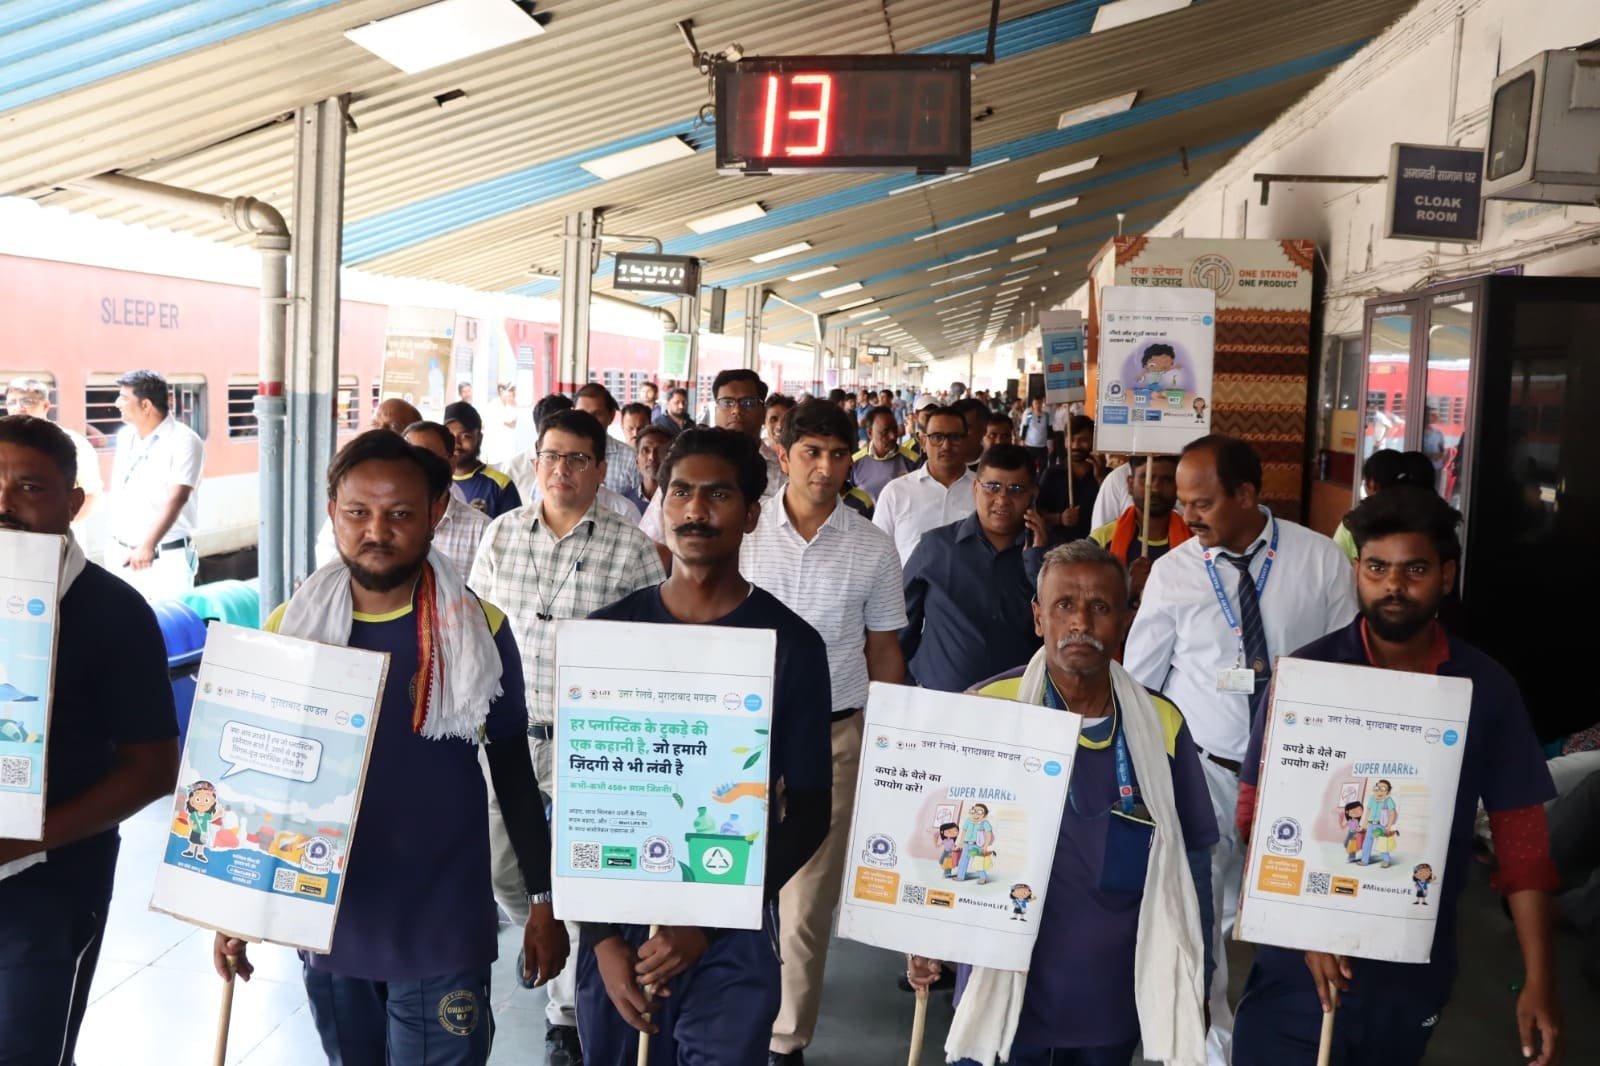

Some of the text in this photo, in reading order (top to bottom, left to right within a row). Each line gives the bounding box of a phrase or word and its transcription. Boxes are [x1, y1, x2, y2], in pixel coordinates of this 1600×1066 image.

[762, 73, 832, 157] 13
[1414, 195, 1461, 208] CLOAK
[1416, 210, 1457, 222] ROOM
[1131, 266, 1148, 276] एक
[1151, 264, 1184, 277] स्टेशन
[1239, 269, 1298, 279] ONE STATION
[1131, 277, 1147, 287] एक
[1239, 279, 1297, 288] ONE PRODUCT
[618, 689, 633, 698] उत्तर
[658, 690, 691, 704] मुरादाबाद
[570, 715, 708, 739] हर प्लास्टिक के टुकड़े की
[1327, 715, 1342, 724] उत्तर
[1366, 719, 1398, 732] मुरादाबाद
[1400, 724, 1423, 734] मण्डल
[570, 736, 707, 756] एक कहानी है, जो हमारी
[921, 740, 936, 749] उत्तर
[961, 745, 995, 758] मुरादाबाद
[997, 751, 1021, 762] मण्डल
[1306, 745, 1315, 755] के
[1334, 750, 1347, 759] का
[612, 757, 624, 772] से
[627, 757, 643, 773] भी
[646, 759, 672, 774] लंबी
[675, 758, 684, 776] है
[1281, 757, 1329, 771] उपयोग करें!
[1353, 762, 1380, 775] SUPER
[899, 768, 909, 777] के
[929, 773, 942, 782] का
[873, 779, 923, 793] उपयोग करें!
[949, 786, 976, 798] SUPER
[1362, 883, 1412, 895] #MissionLiFE
[958, 897, 1008, 911] #MissionLiFE
